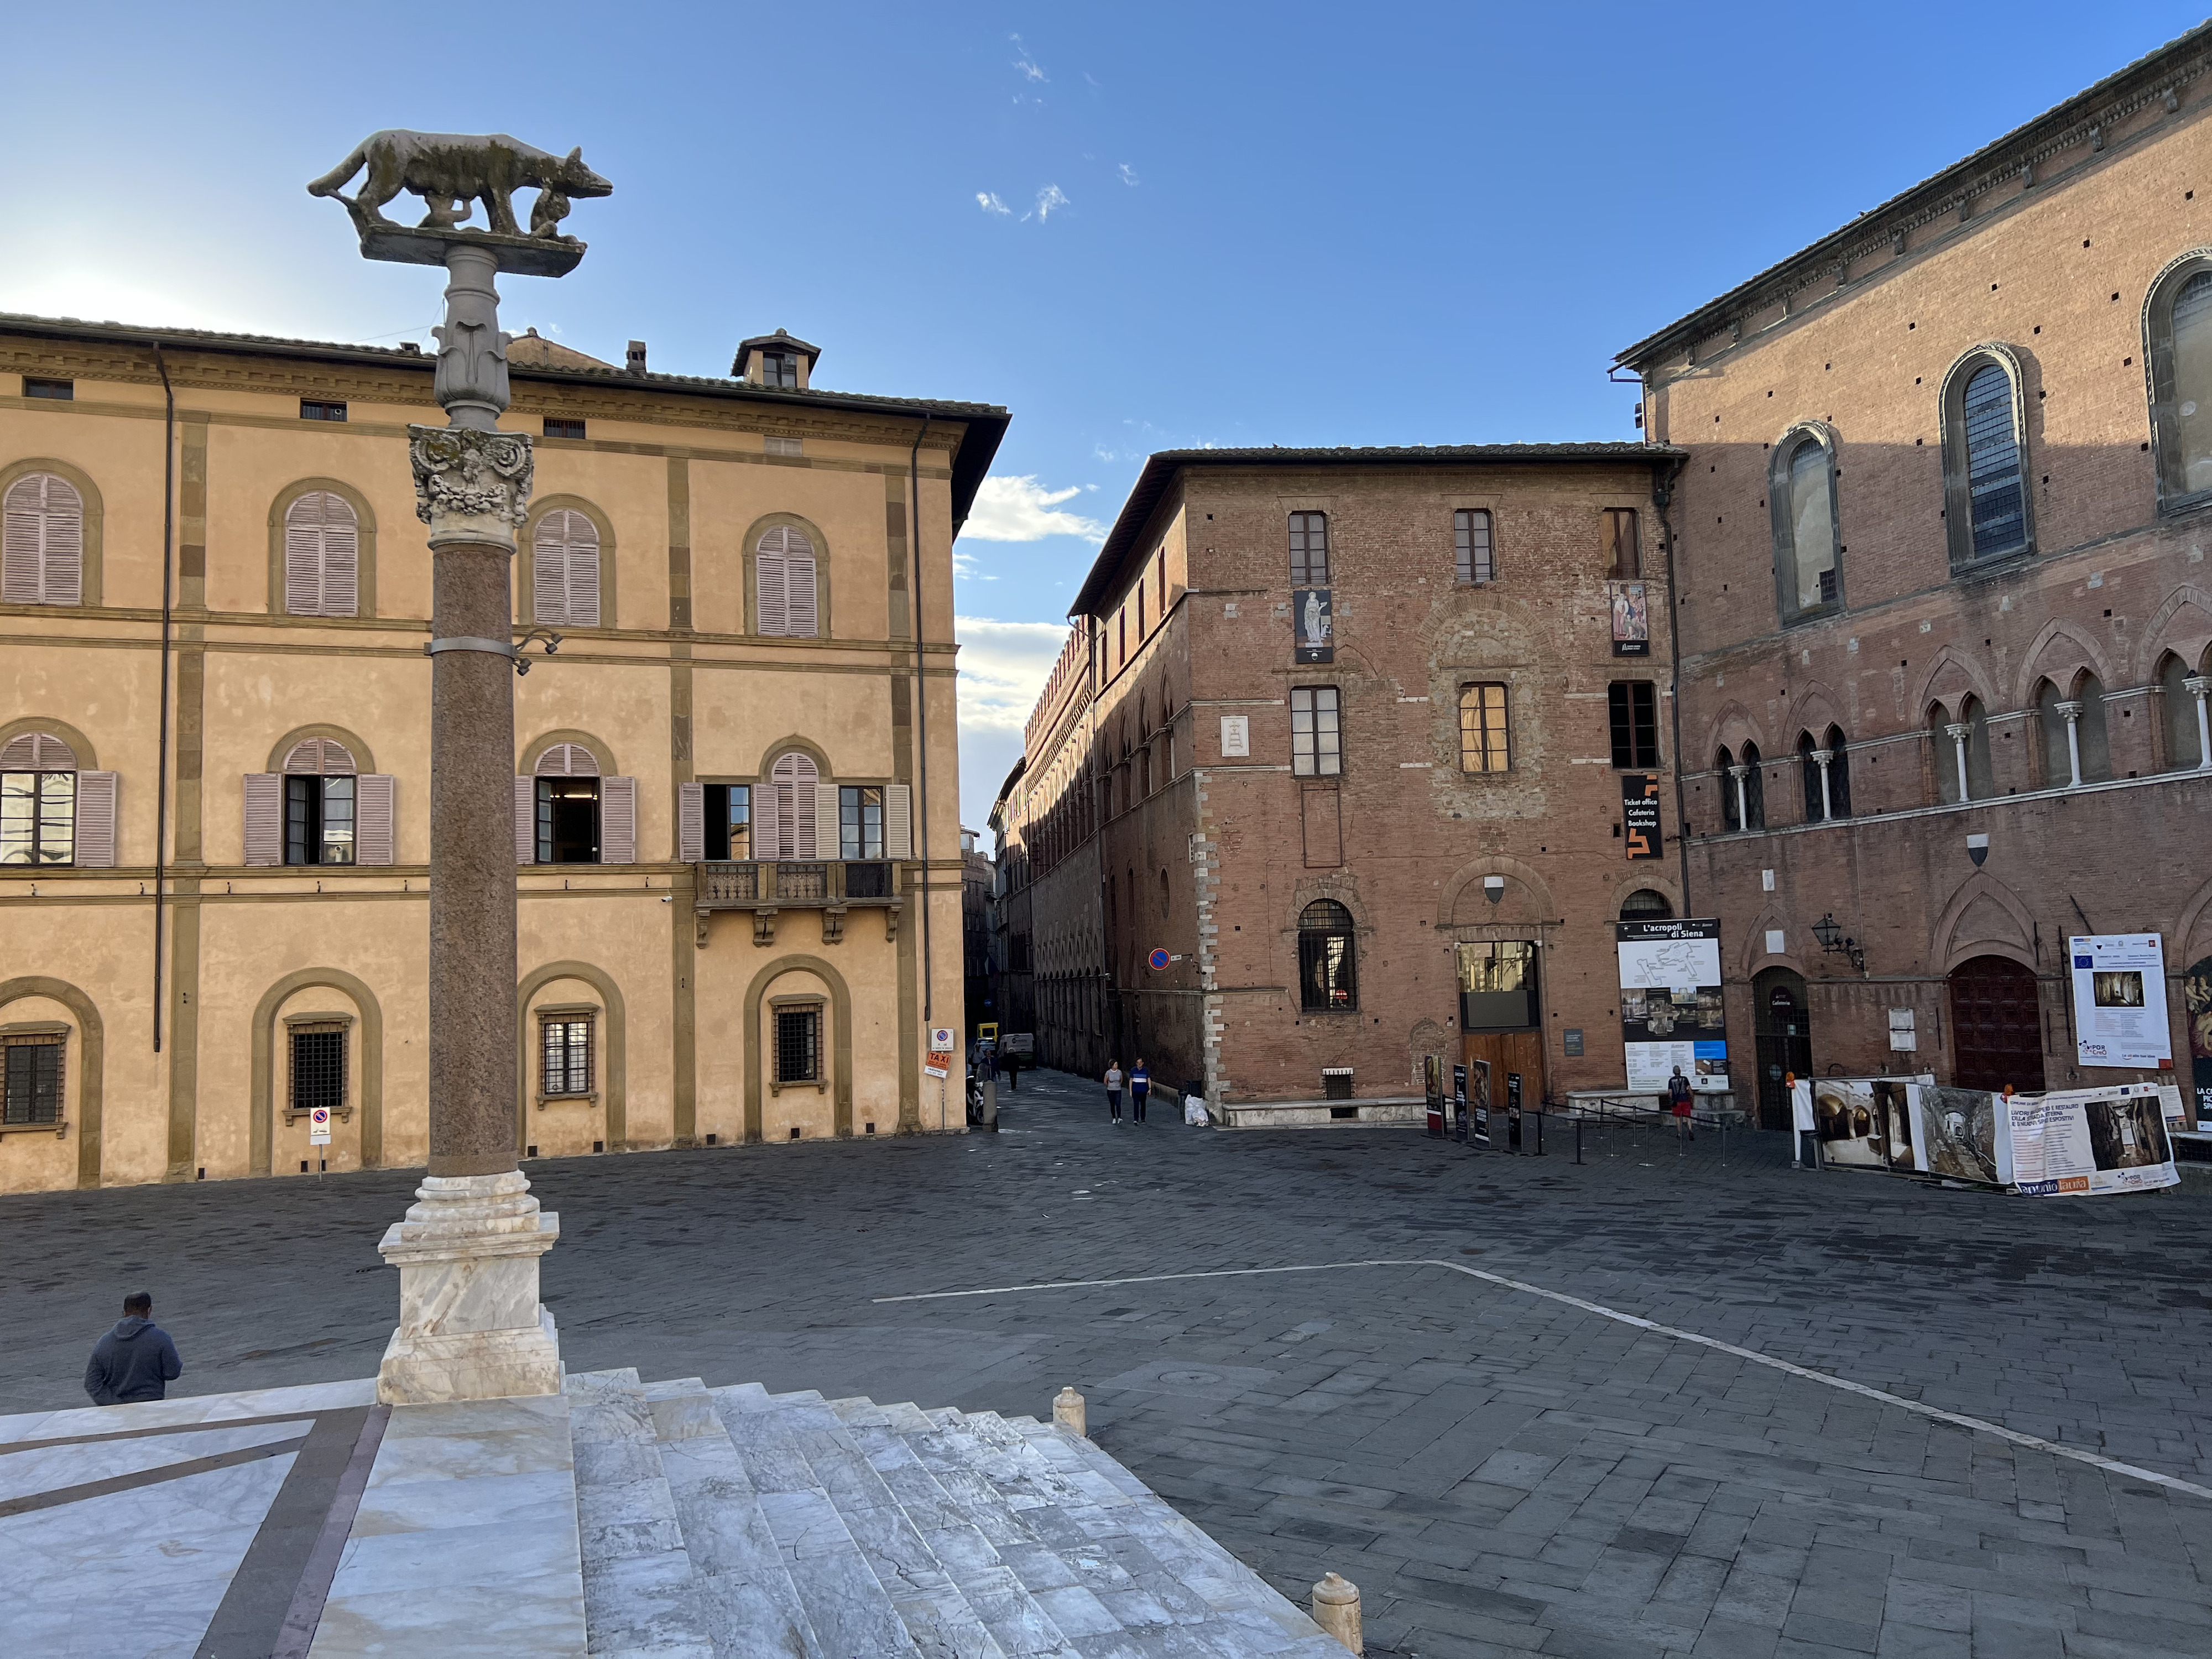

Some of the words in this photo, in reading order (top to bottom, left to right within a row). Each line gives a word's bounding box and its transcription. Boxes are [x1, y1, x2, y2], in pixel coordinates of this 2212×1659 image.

[1628, 820, 1657, 828] Bookshop
[1643, 923, 1682, 932] L'acropoli
[930, 1052, 949, 1063] TAXI
[2205, 1087, 2212, 1095] C
